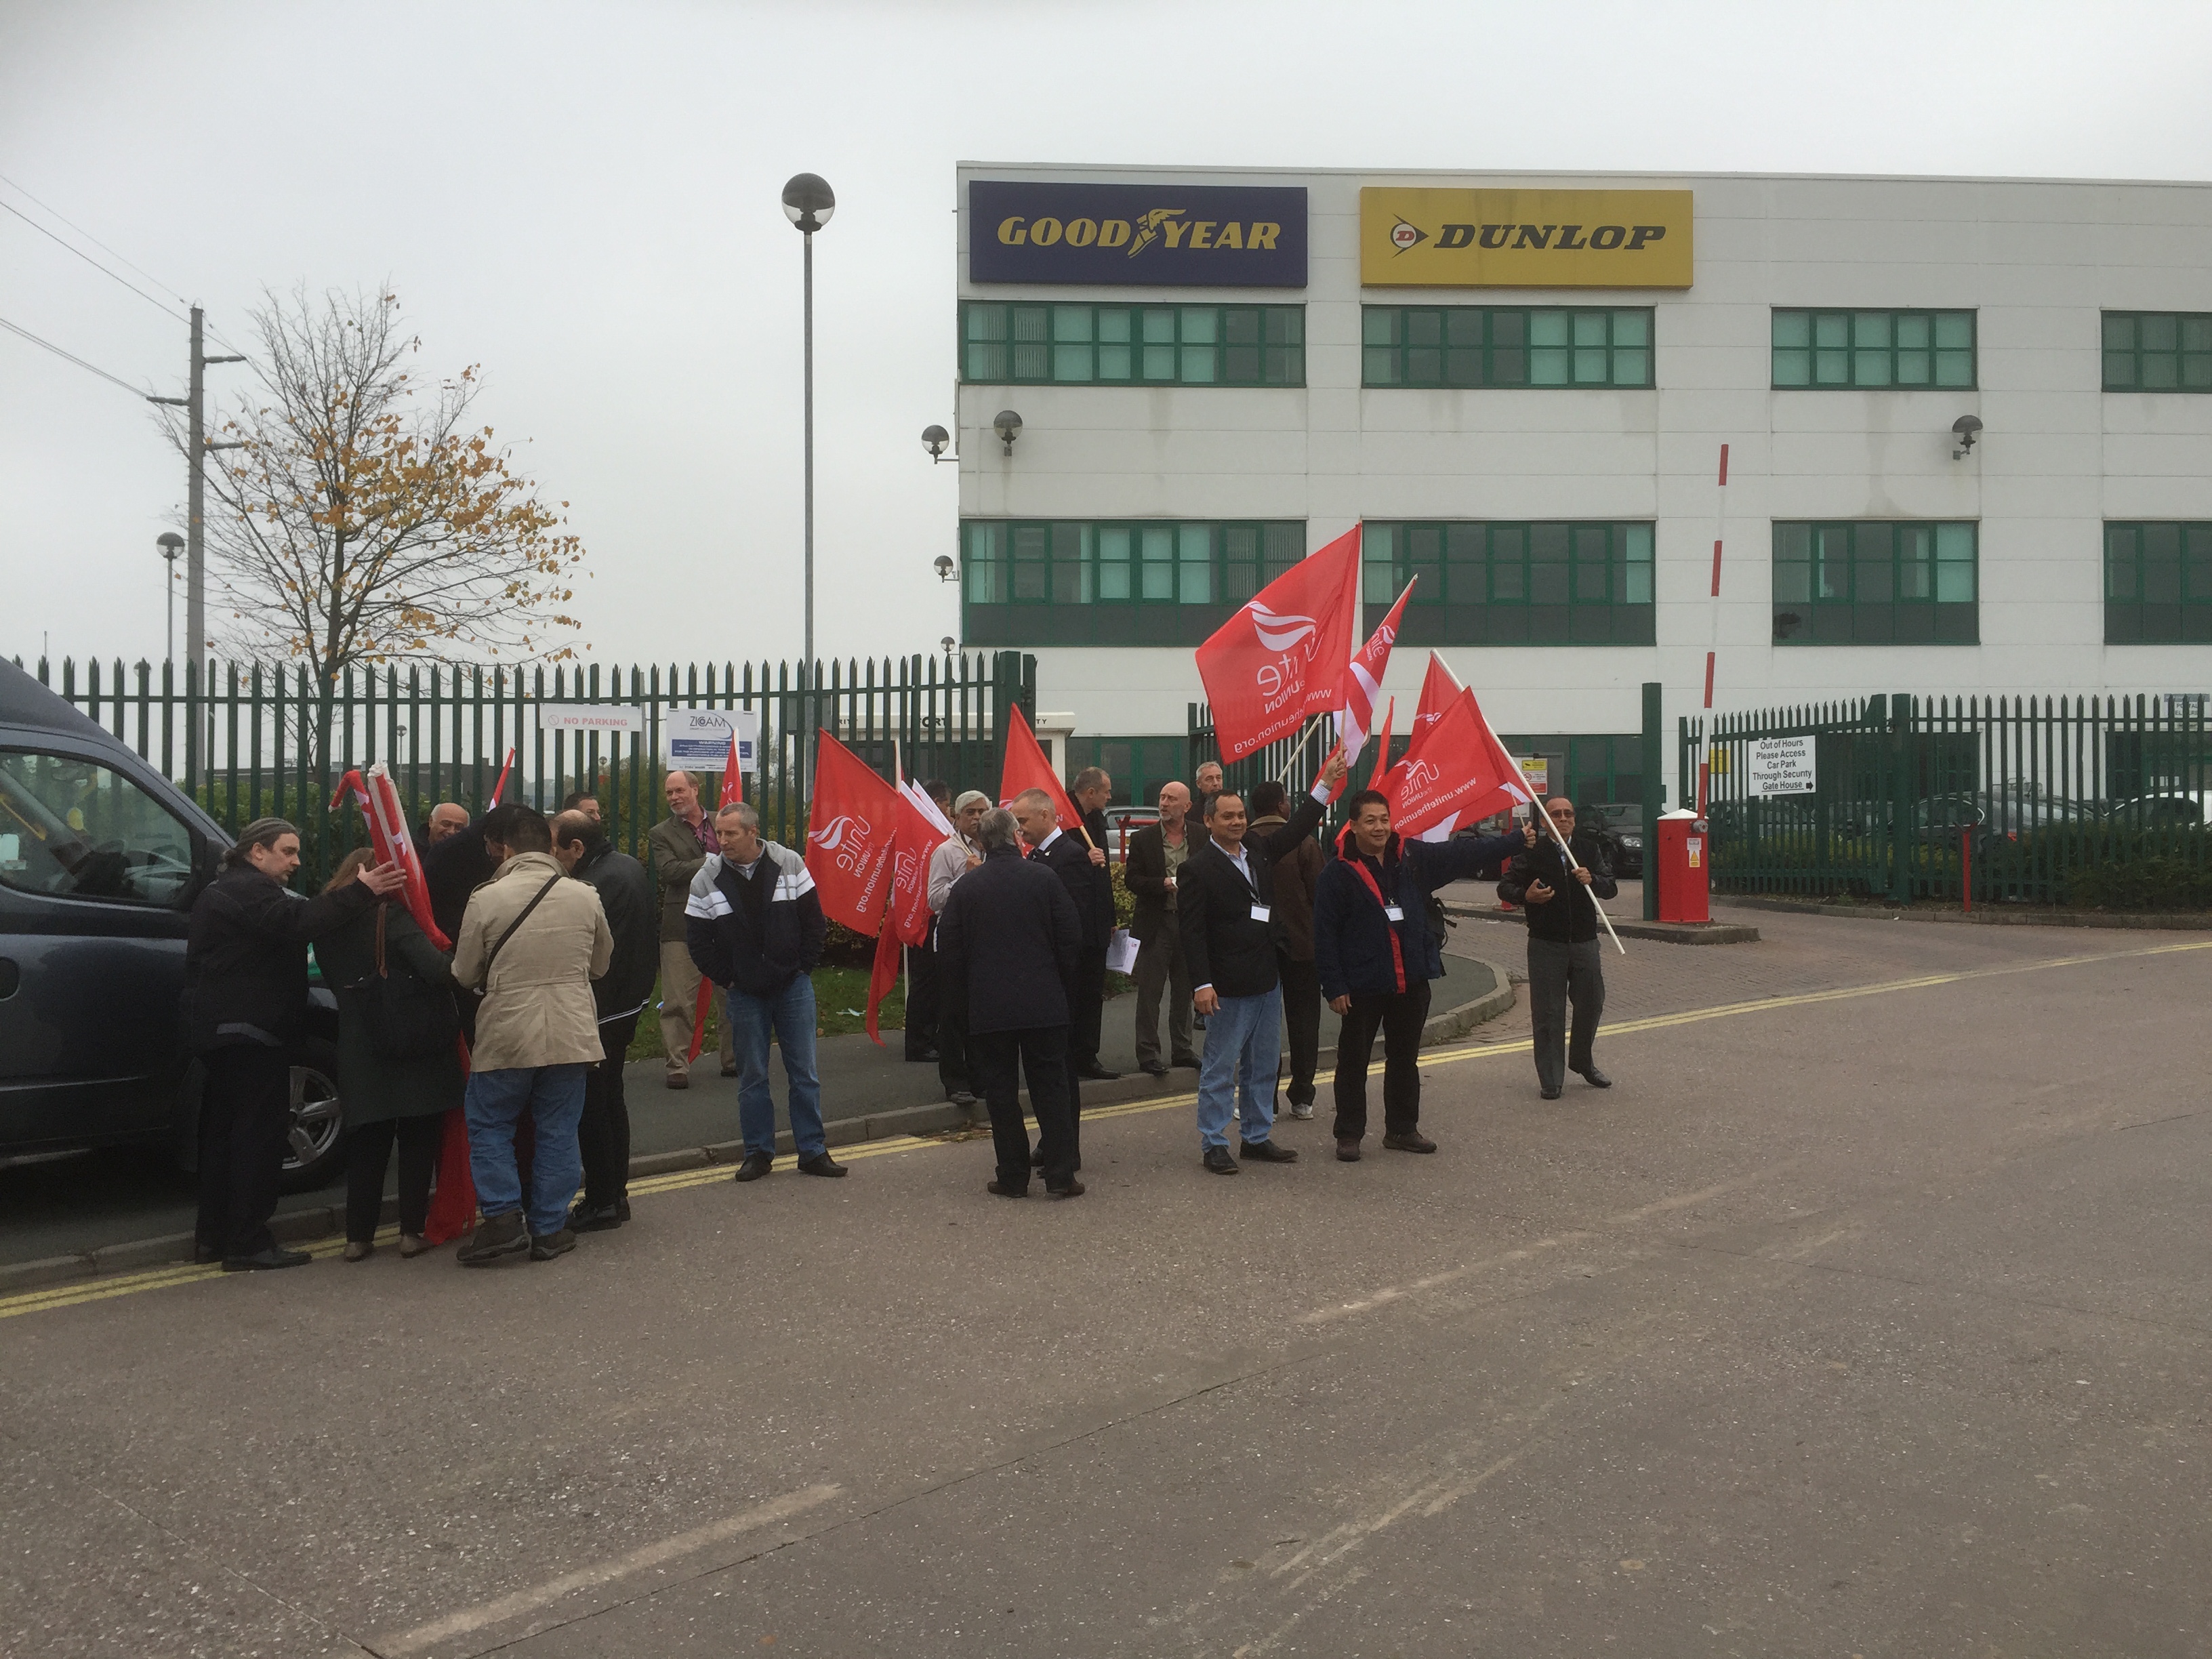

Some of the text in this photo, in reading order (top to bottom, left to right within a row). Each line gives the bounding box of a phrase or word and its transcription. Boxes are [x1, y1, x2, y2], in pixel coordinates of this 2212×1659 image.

[1433, 224, 1666, 250] DUNLOP
[582, 718, 628, 726] PARKING
[1760, 739, 1803, 750] Out of Hours
[1756, 750, 1806, 760] Please Access
[1767, 760, 1797, 769] Car Park
[1753, 770, 1812, 781] Through Security
[1763, 782, 1778, 790] Gate
